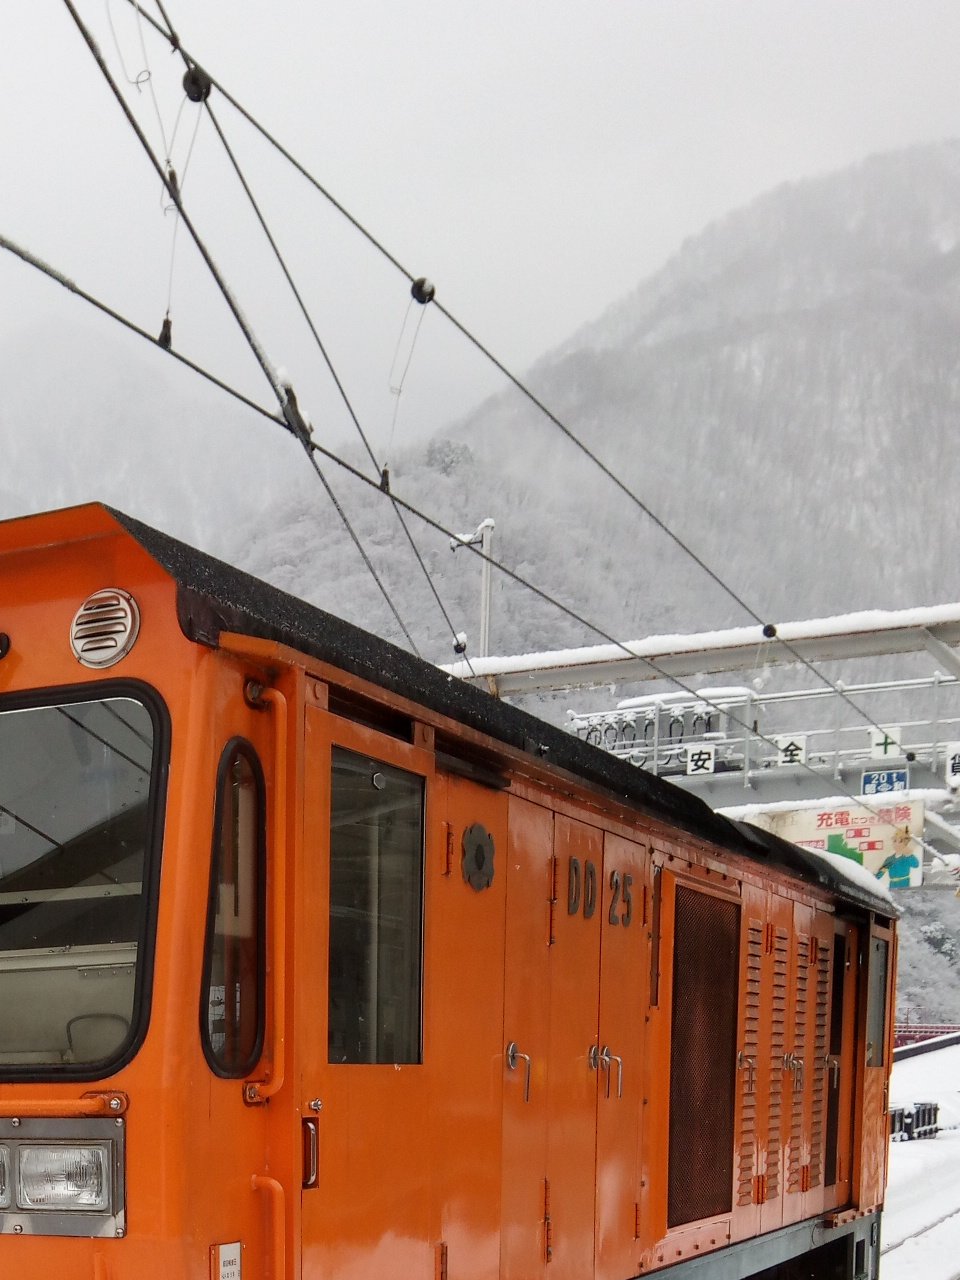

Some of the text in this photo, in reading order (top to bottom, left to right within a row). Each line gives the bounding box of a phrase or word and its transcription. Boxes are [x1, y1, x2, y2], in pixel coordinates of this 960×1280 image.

[690, 741, 803, 772] 安 全
[568, 856, 633, 928] DD 25
